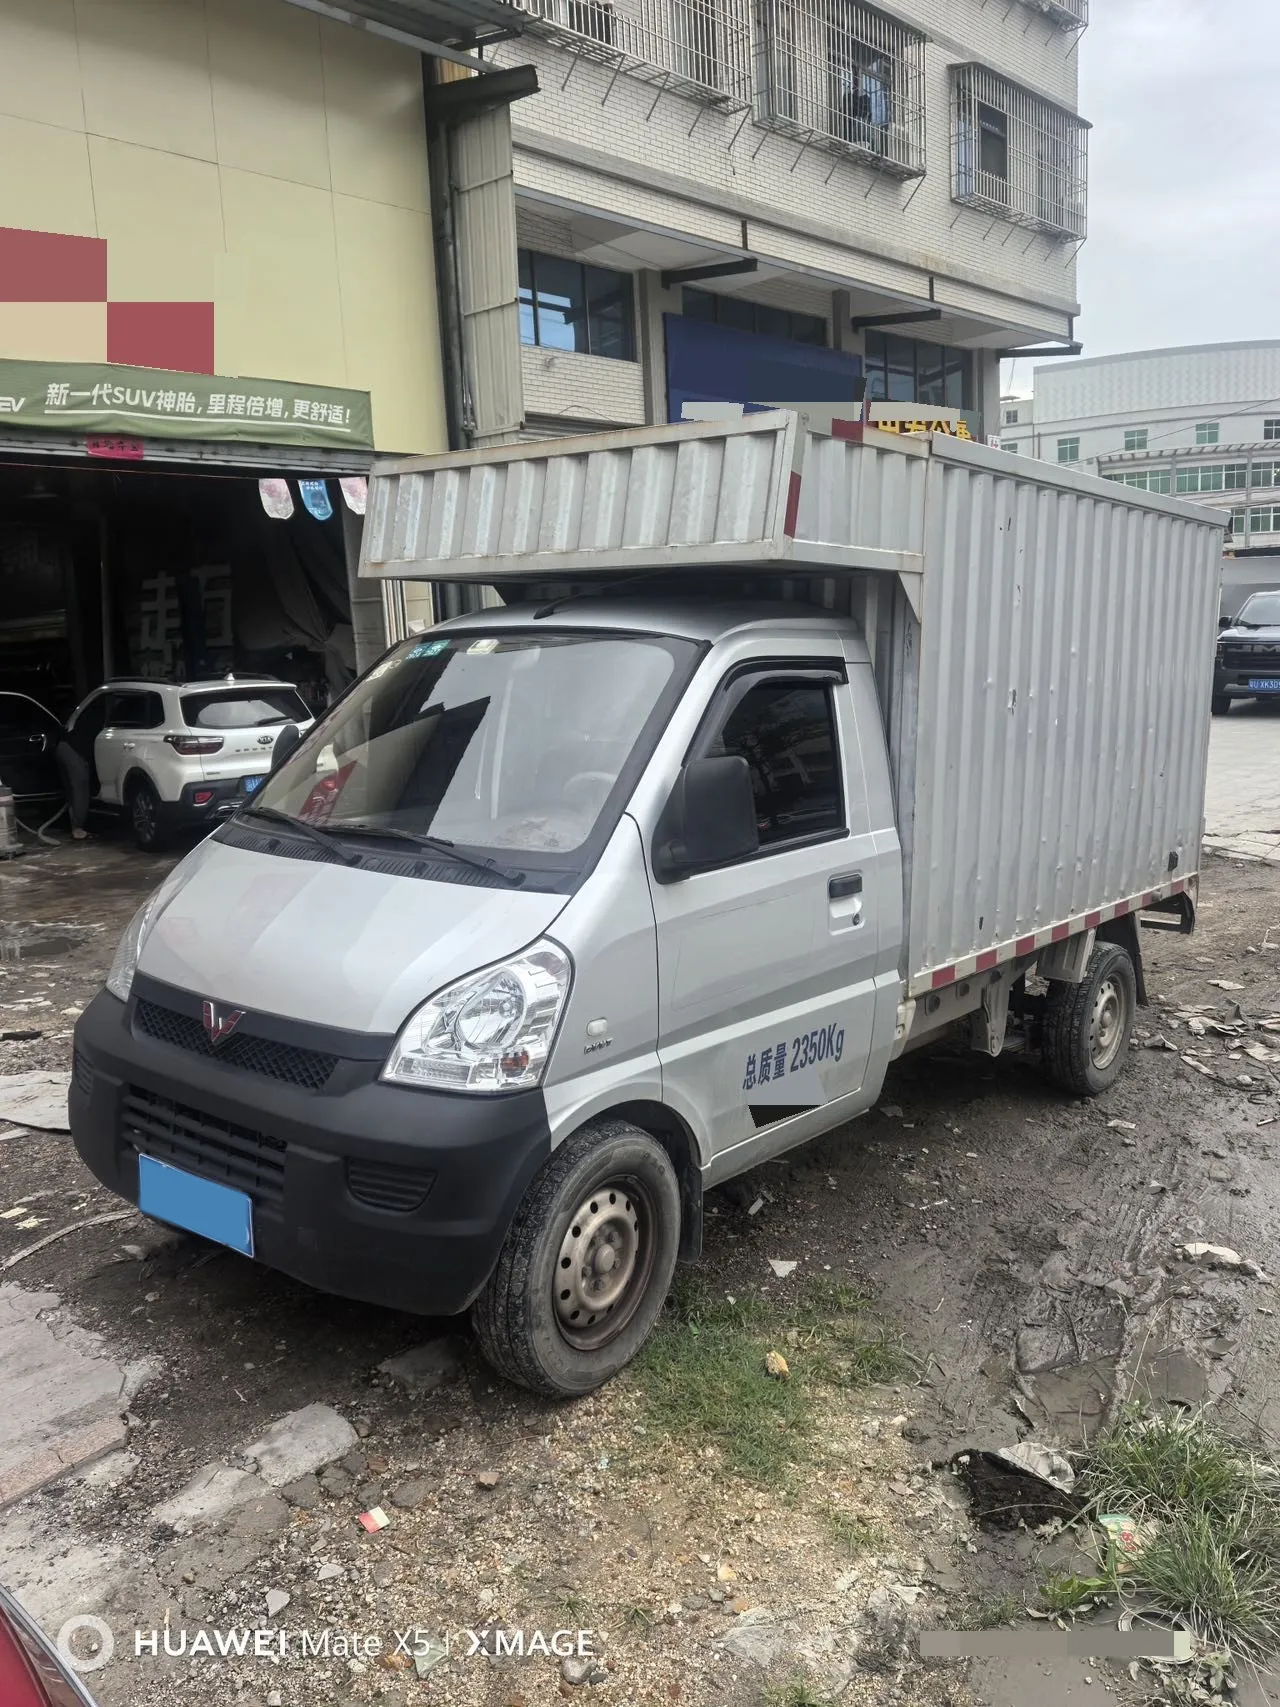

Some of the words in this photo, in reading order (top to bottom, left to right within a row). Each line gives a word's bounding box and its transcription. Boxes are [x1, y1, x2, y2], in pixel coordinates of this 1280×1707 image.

[742, 1041, 787, 1090] 总质量
[790, 1022, 845, 1073] 2350Kg
